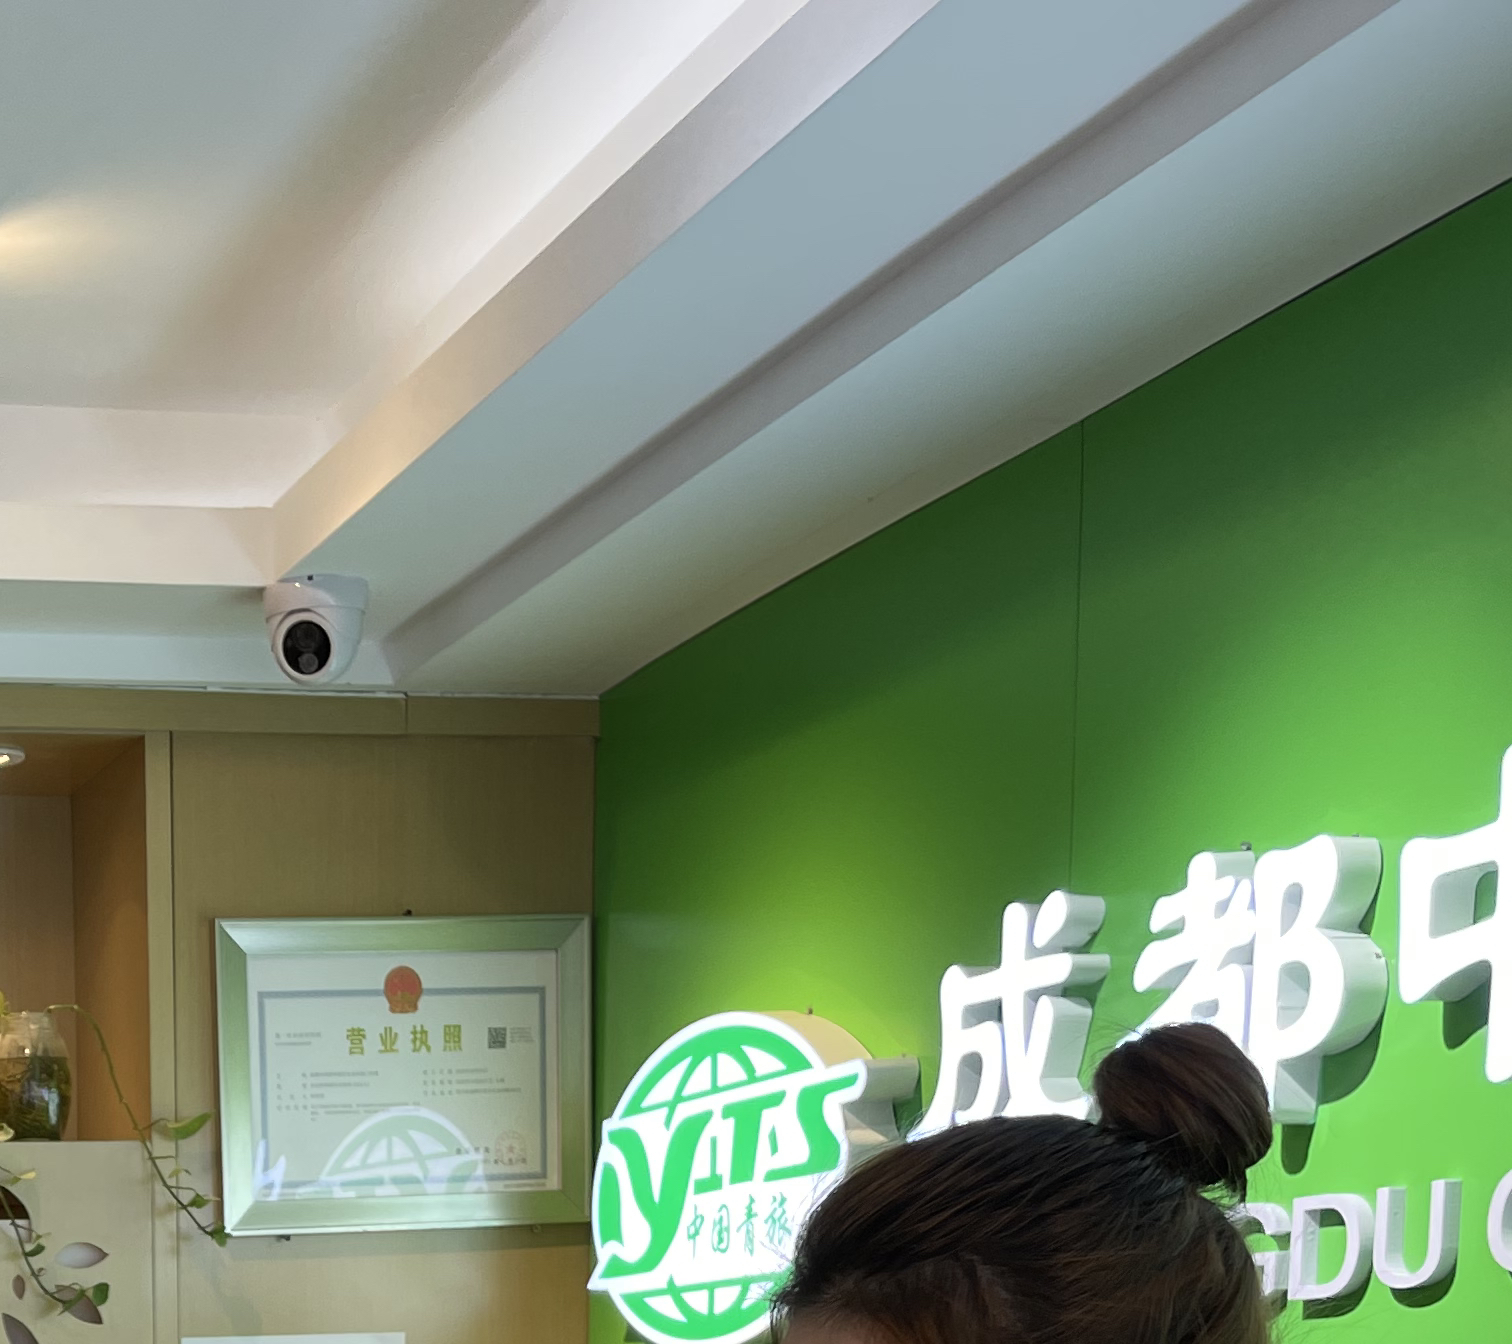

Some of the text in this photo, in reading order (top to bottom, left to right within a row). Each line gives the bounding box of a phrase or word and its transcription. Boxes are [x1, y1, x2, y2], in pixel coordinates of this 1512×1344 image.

[346, 1023, 464, 1055] 营业执照
[686, 1191, 792, 1260] 中国青旅
